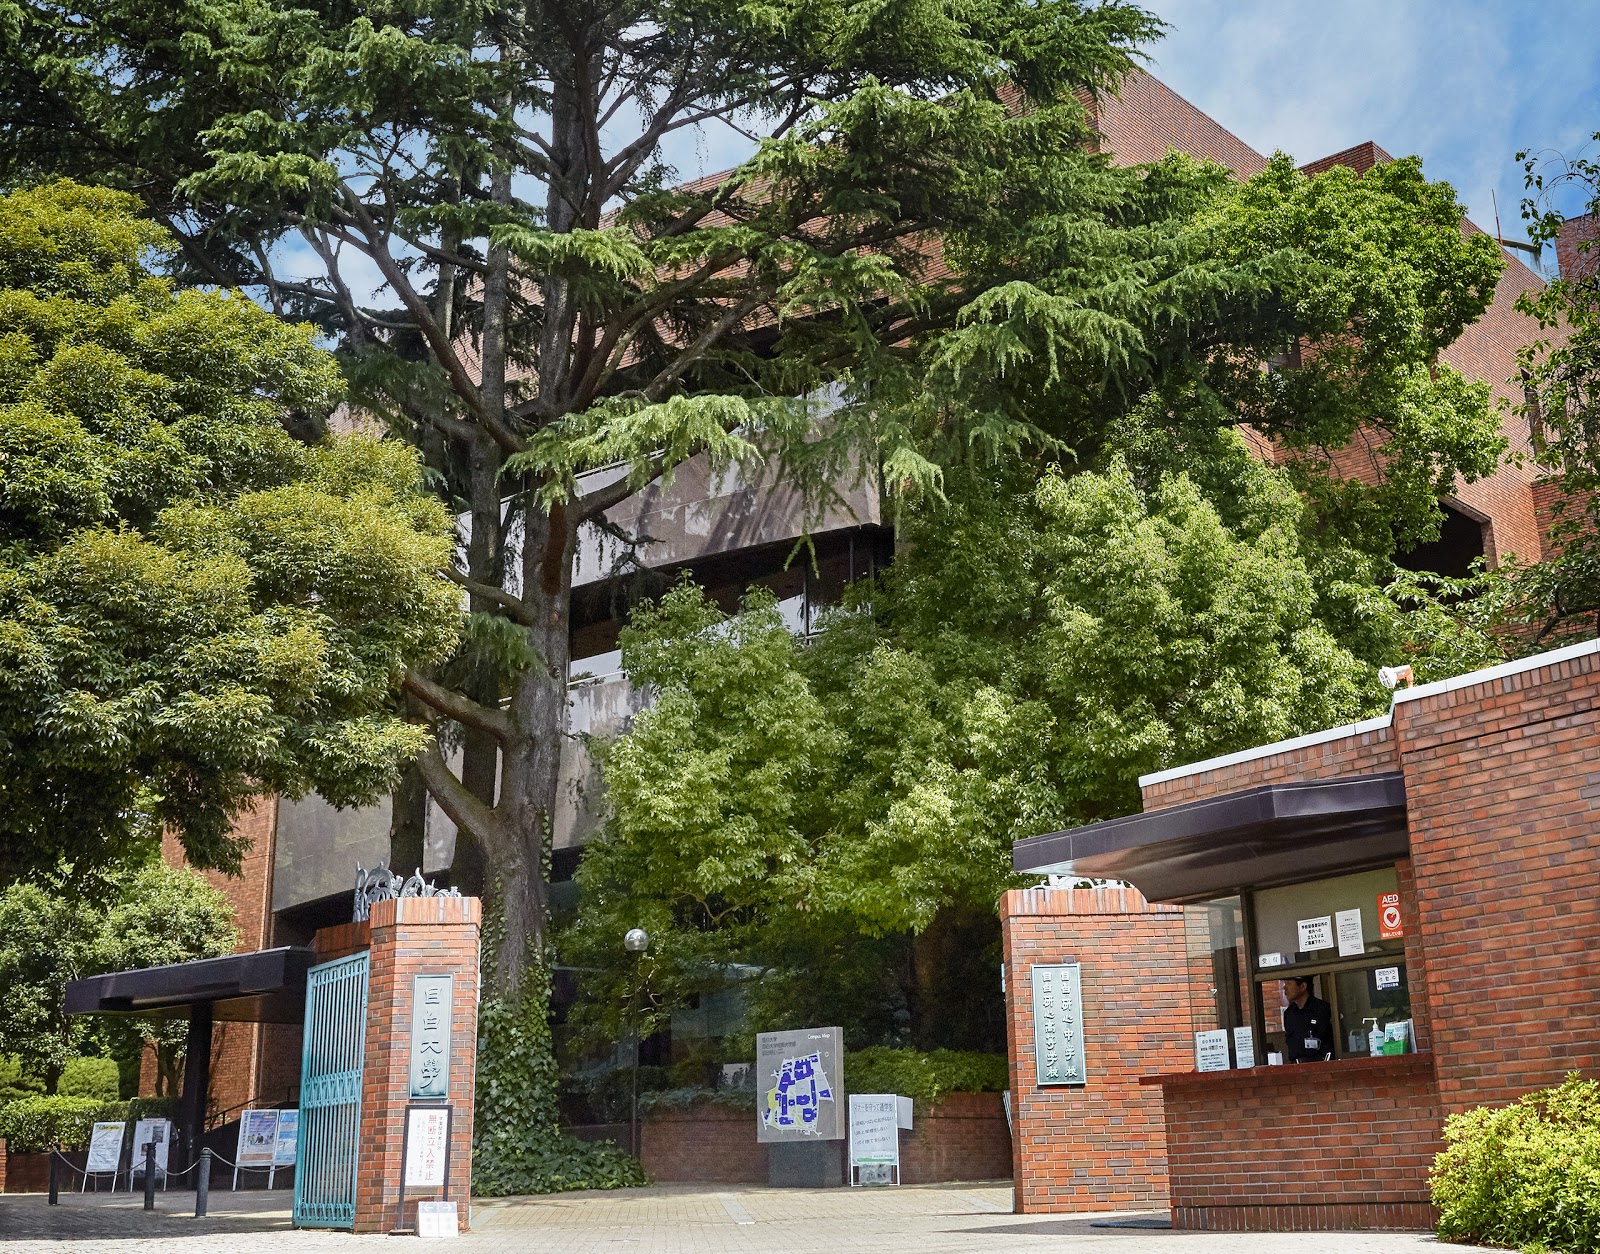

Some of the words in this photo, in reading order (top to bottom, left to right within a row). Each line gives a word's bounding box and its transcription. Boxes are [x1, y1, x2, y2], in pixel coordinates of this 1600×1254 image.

[1382, 894, 1399, 903] AED
[1262, 956, 1278, 965] 受付
[807, 1033, 822, 1041] Campus
[822, 1032, 831, 1041] Map
[424, 1114, 437, 1181] 無断立入禁止
